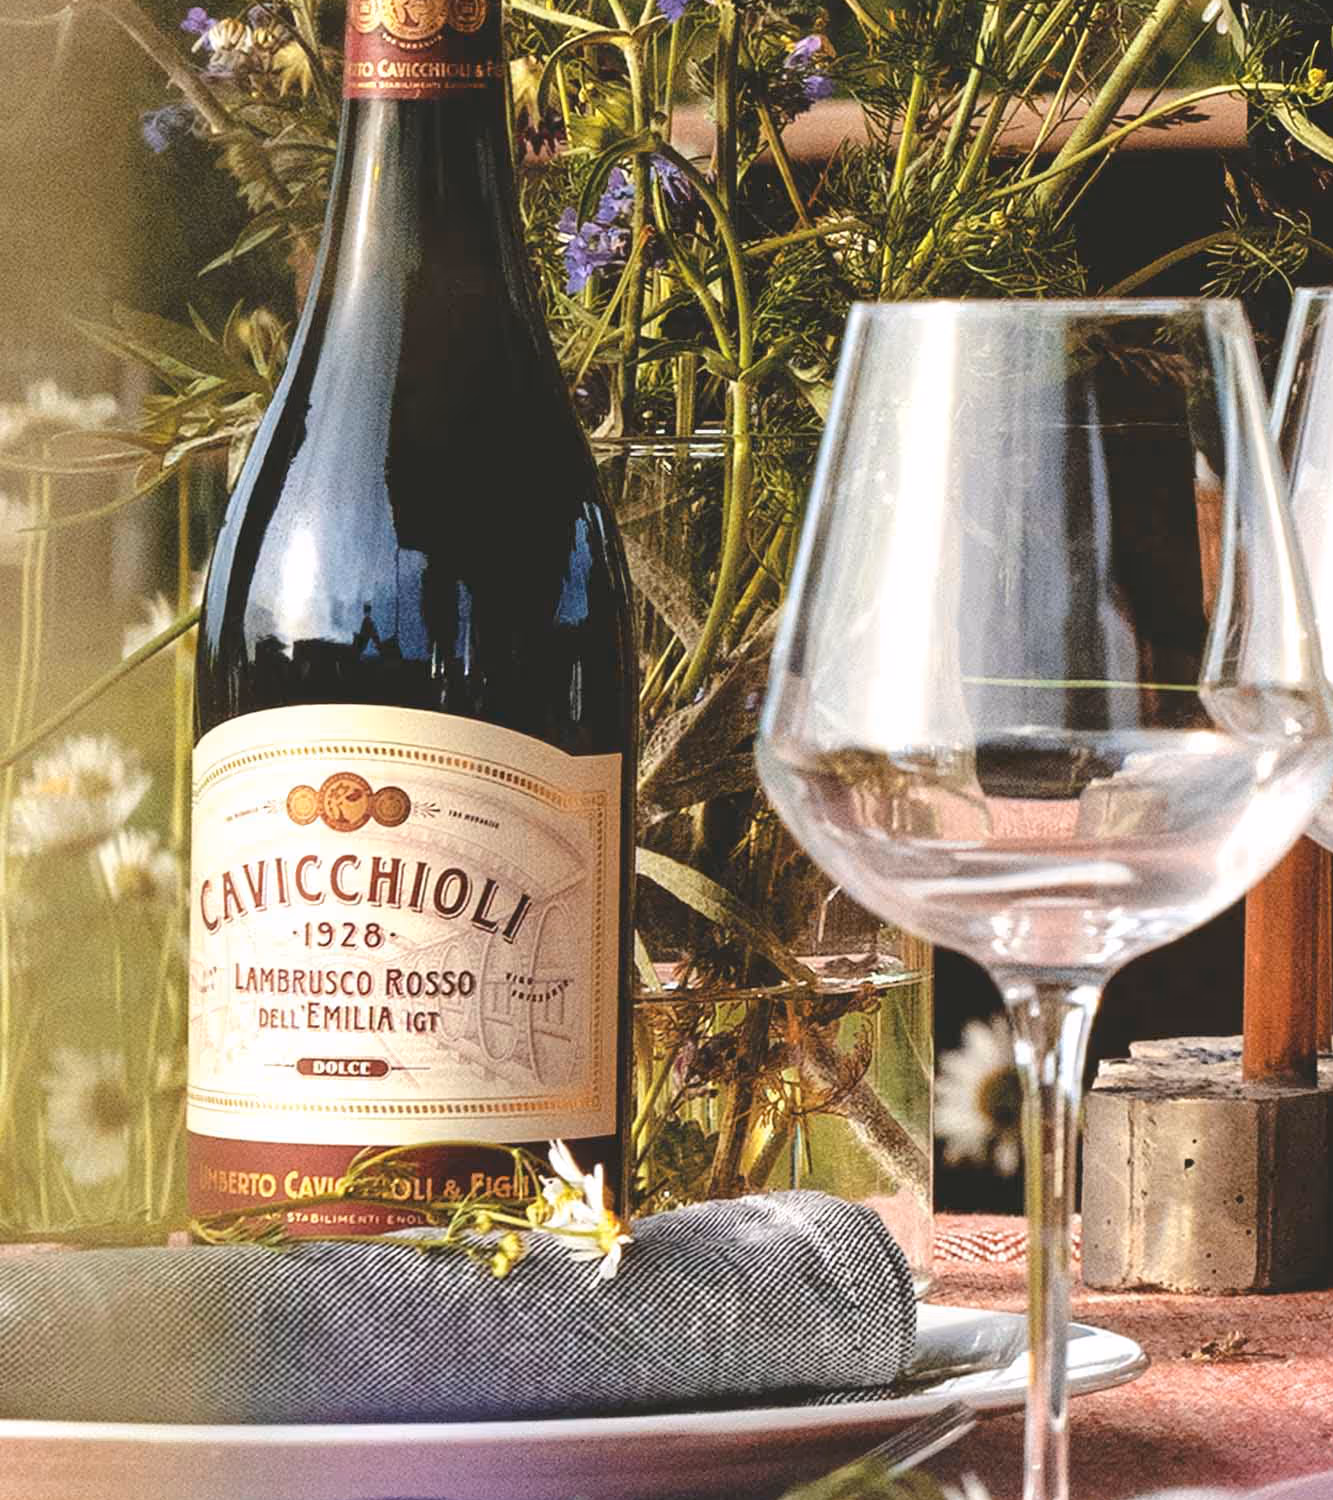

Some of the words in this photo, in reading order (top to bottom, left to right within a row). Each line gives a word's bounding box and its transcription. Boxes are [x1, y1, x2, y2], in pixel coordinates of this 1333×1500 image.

[200, 854, 533, 945] CAVICCHIOLI
[304, 922, 384, 949] 1928
[385, 968, 477, 997] ROSSO
[406, 1011, 441, 1034] IGT
[312, 1061, 372, 1076] DOLCE
[442, 1178, 461, 1199] &
